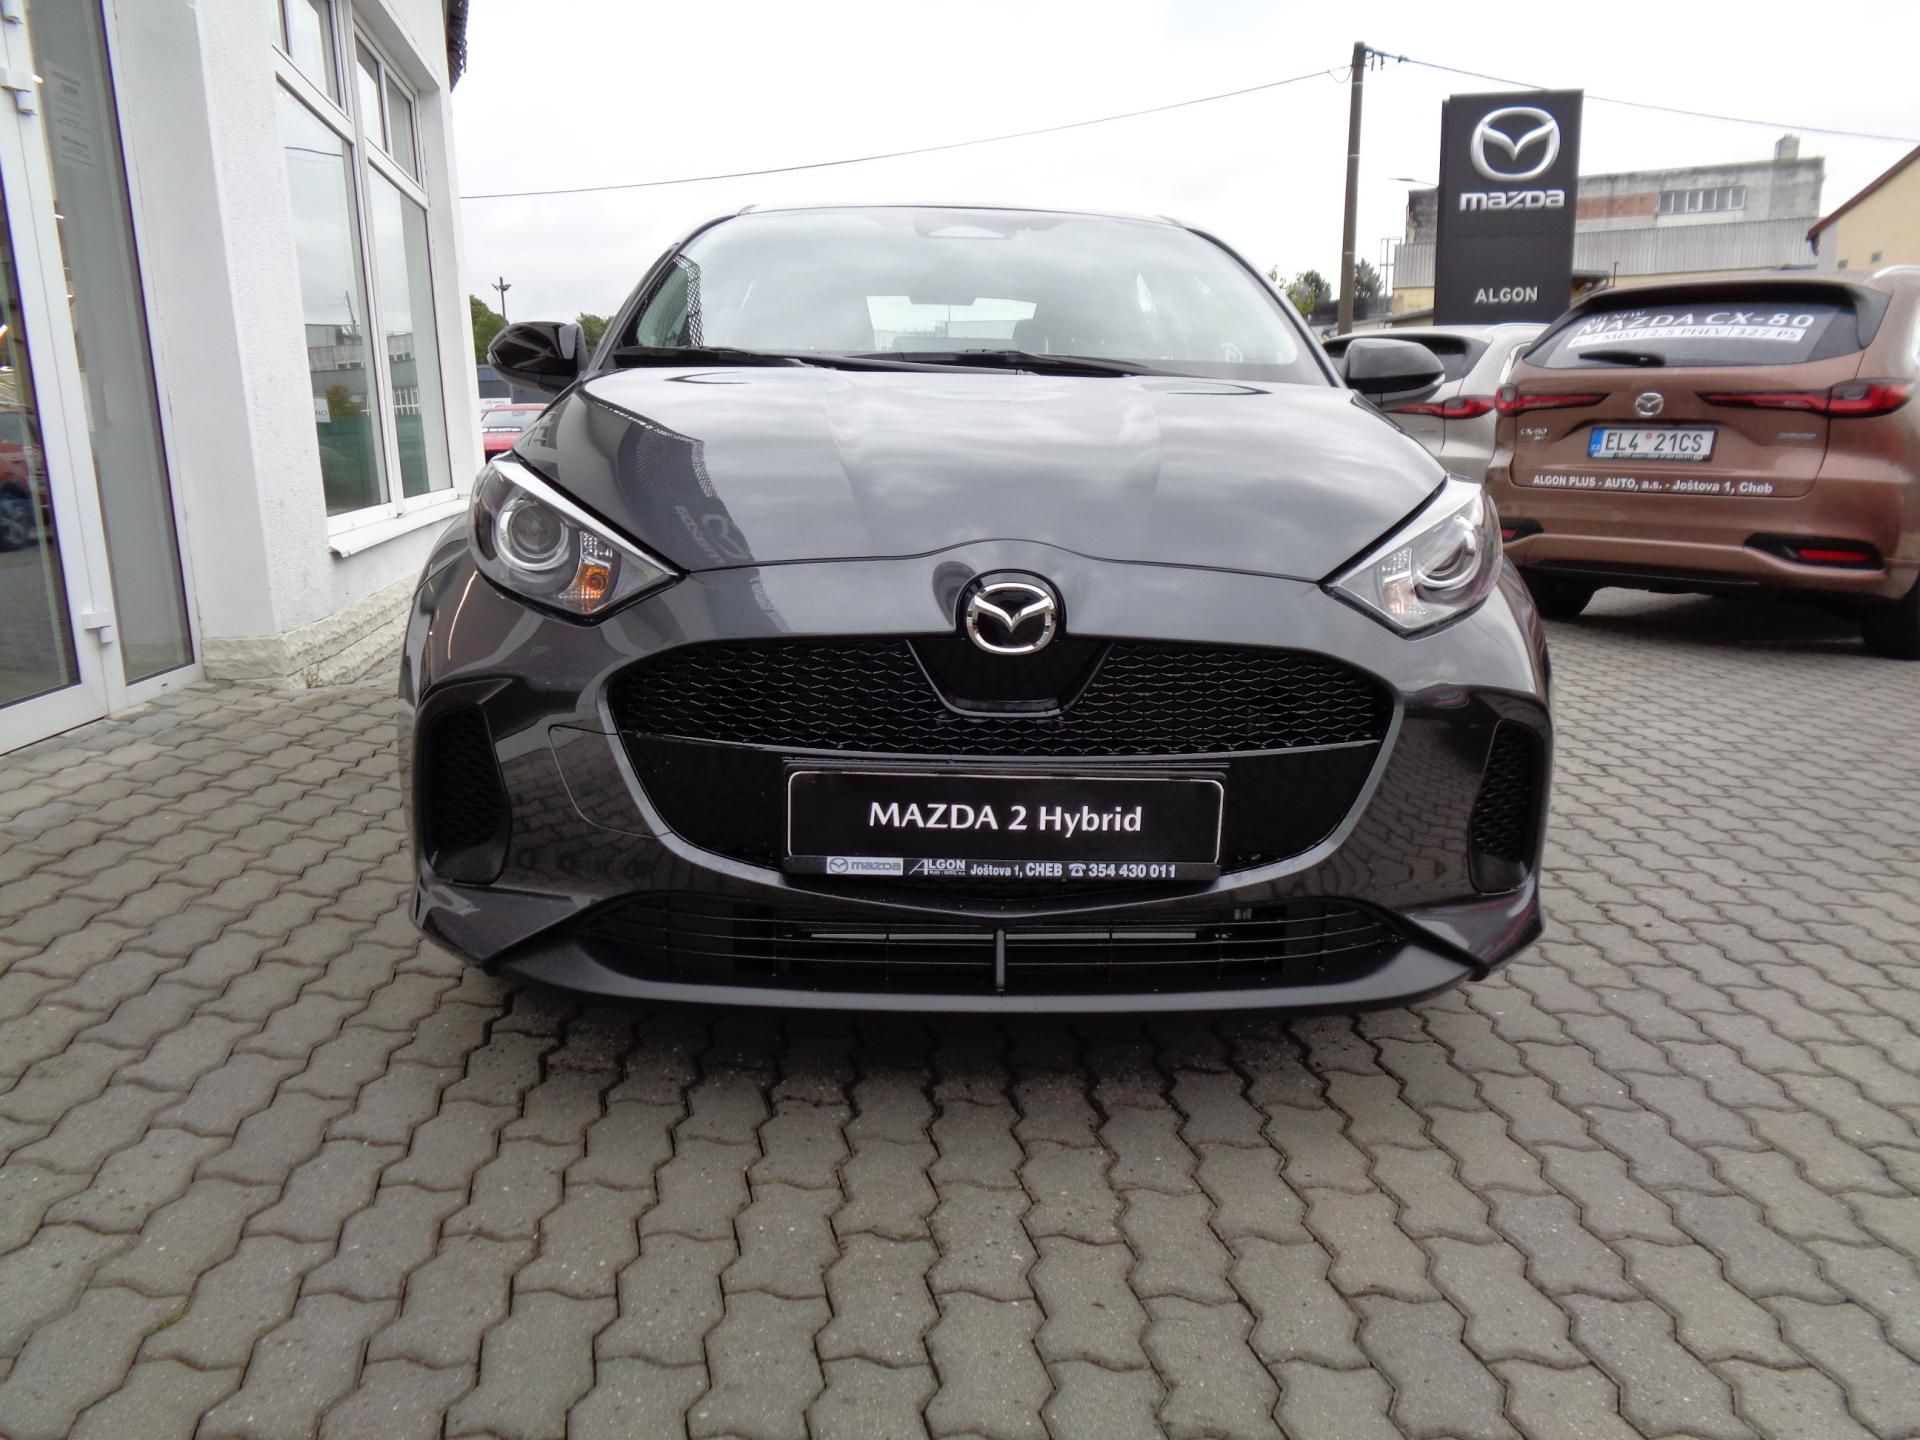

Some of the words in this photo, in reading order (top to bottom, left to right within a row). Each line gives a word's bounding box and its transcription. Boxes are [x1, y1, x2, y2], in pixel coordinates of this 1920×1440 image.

[1474, 286, 1538, 304] ALGON
[1577, 314, 1694, 336] MAZDA
[1704, 312, 1815, 328] CX-80
[1604, 432, 1640, 451] EL4
[1653, 433, 1704, 453] 21CS
[1533, 475, 1567, 486] ALGON
[1568, 476, 1597, 487] PLUS
[1604, 478, 1639, 491] AUTO,
[1739, 482, 1773, 493] Cheb
[869, 802, 999, 830] MAZDA
[1008, 805, 1028, 830] 2
[1039, 806, 1142, 838] Hybrid
[909, 859, 966, 875] ALGON
[970, 864, 1012, 876] Joštova
[1025, 863, 1063, 876] CHEB
[1088, 864, 1116, 877] 354
[1119, 864, 1147, 877] 430
[1150, 864, 1176, 878] 011
